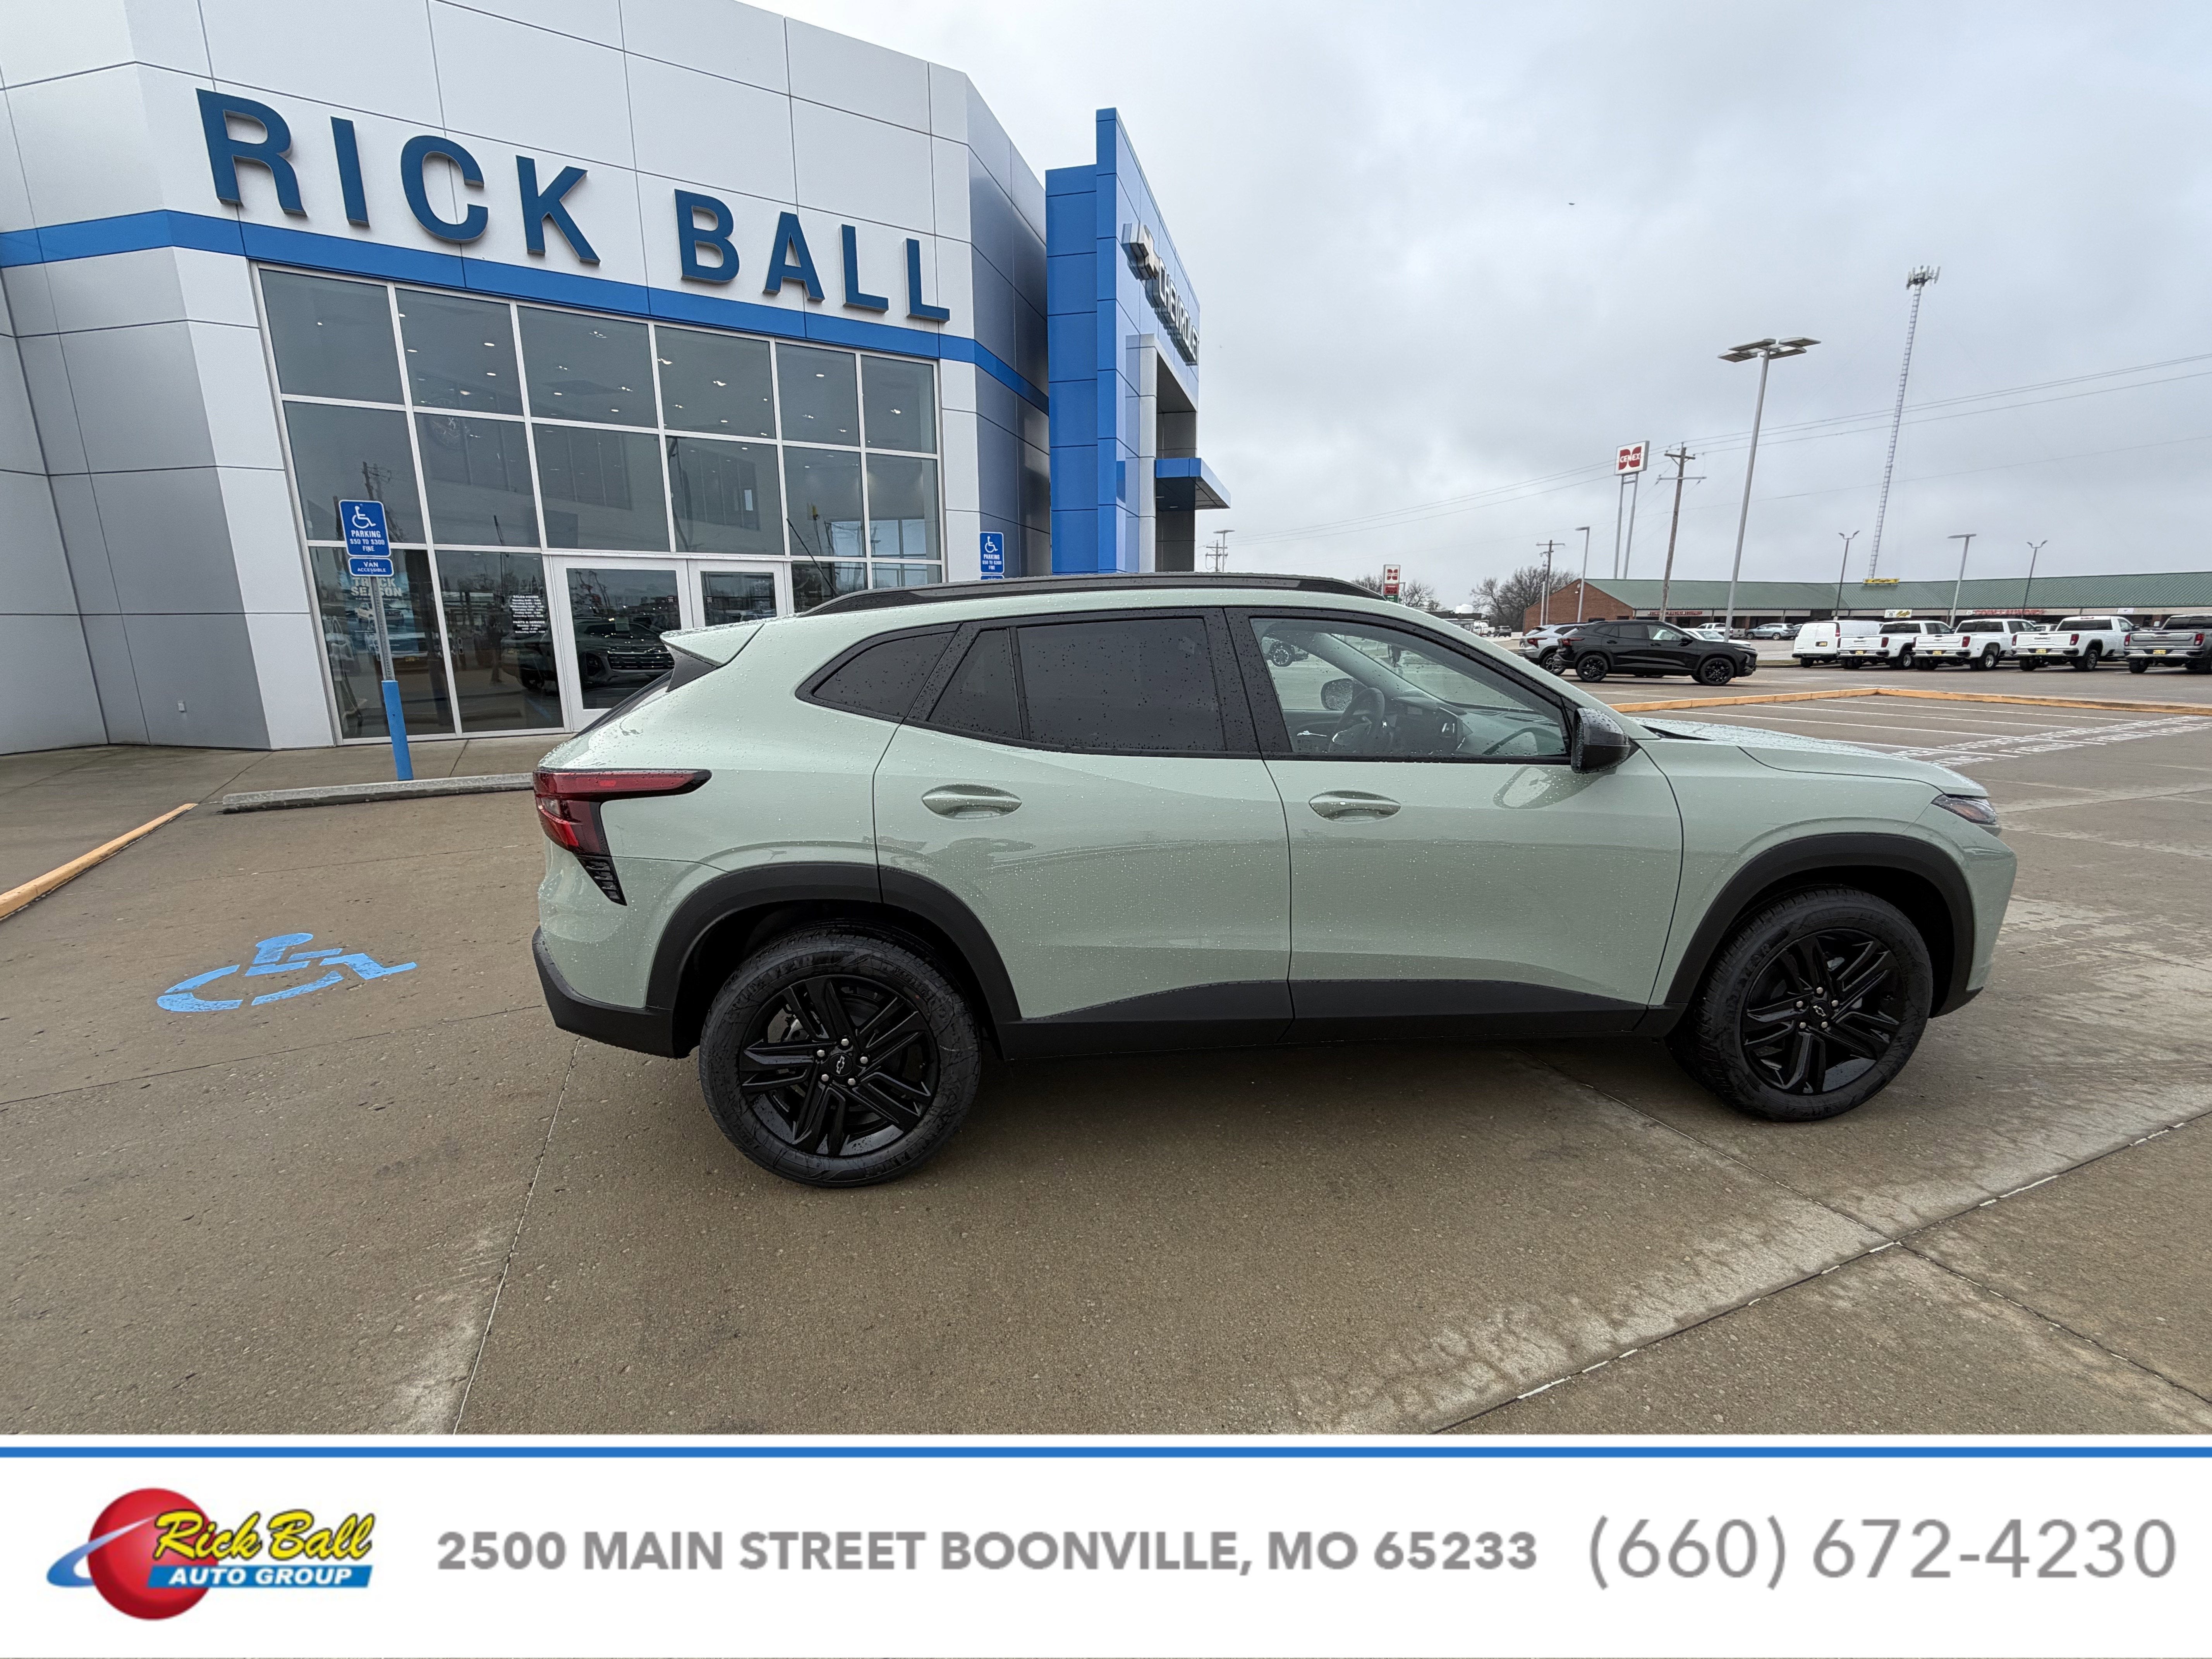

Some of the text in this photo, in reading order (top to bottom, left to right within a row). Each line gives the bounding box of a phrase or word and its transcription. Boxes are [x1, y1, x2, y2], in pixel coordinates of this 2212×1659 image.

[195, 89, 950, 322] RICK BALL
[1620, 453, 1642, 463] CENEX
[351, 530, 381, 538] PARKING
[352, 577, 396, 587] TRCK
